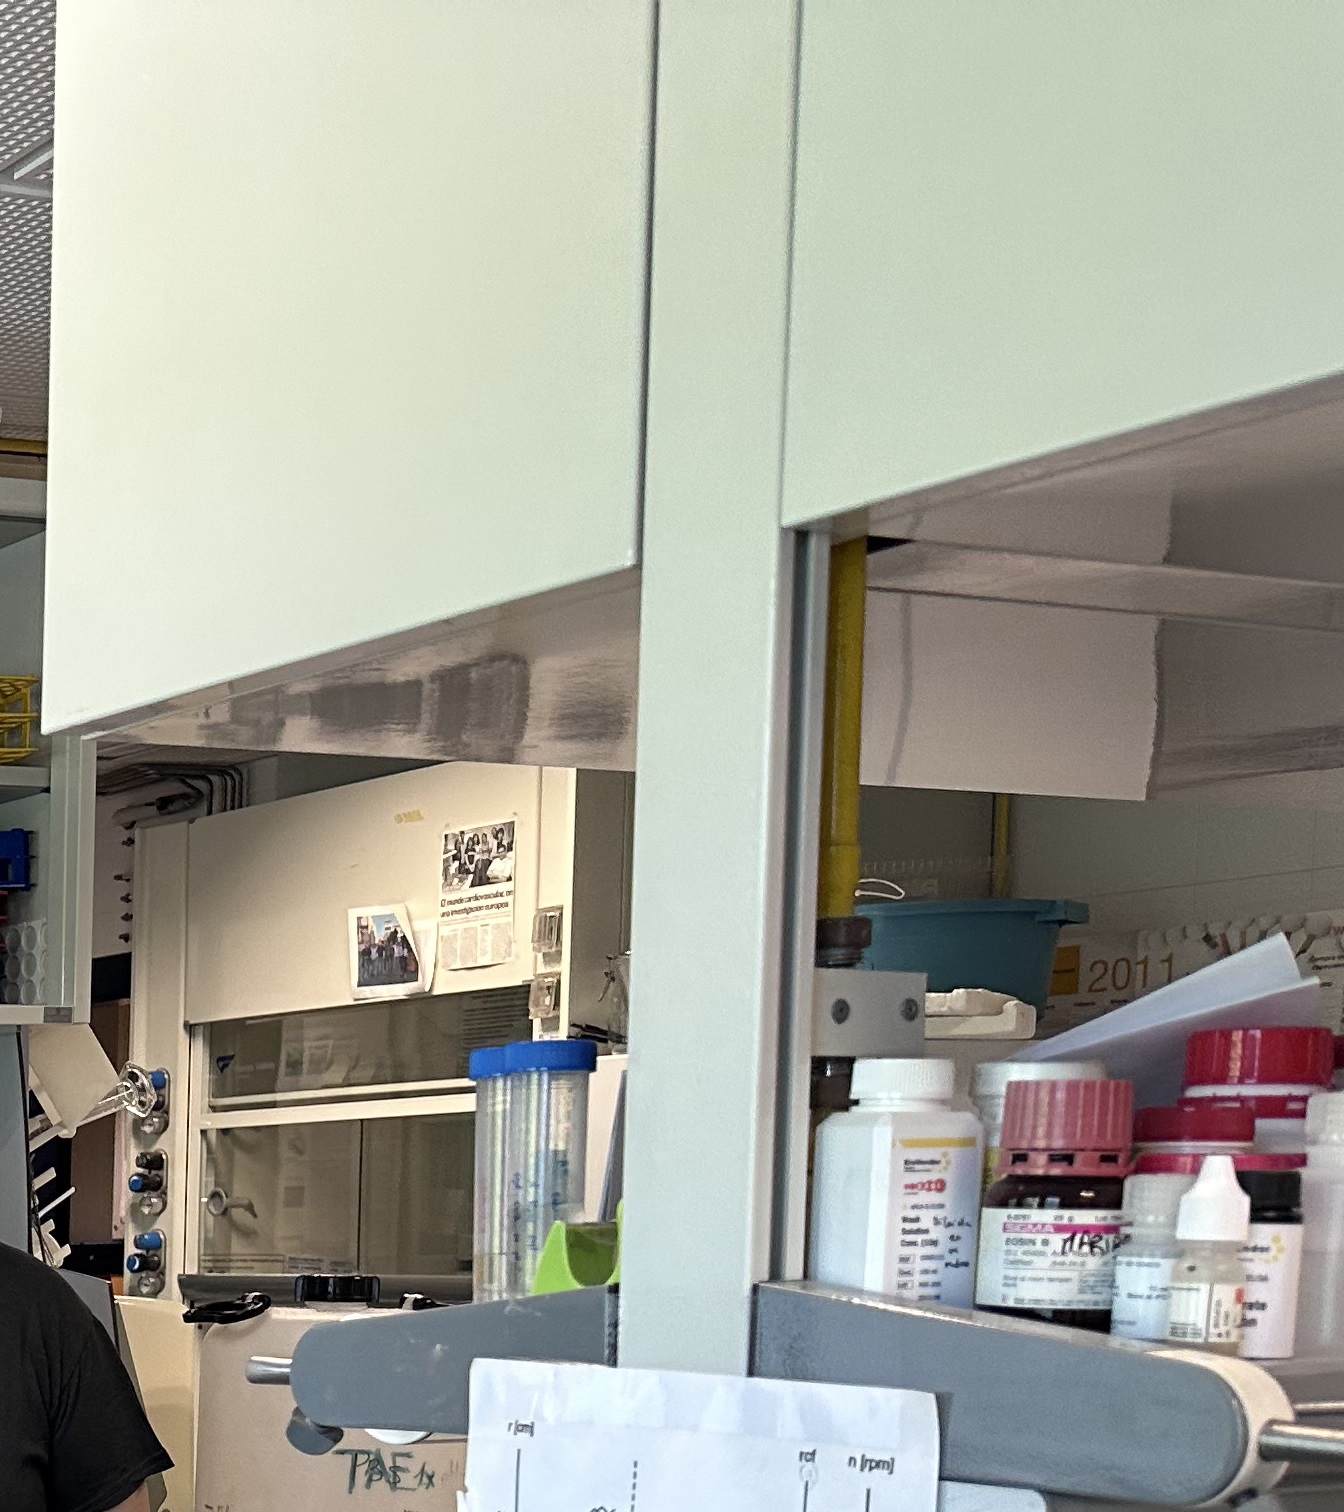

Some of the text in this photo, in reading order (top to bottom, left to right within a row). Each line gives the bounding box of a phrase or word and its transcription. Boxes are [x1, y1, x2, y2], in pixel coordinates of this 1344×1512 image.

[1005, 1224, 1054, 1232] SIGMA
[799, 1449, 817, 1463] rcf
[848, 1454, 894, 1475] n [rpm]
